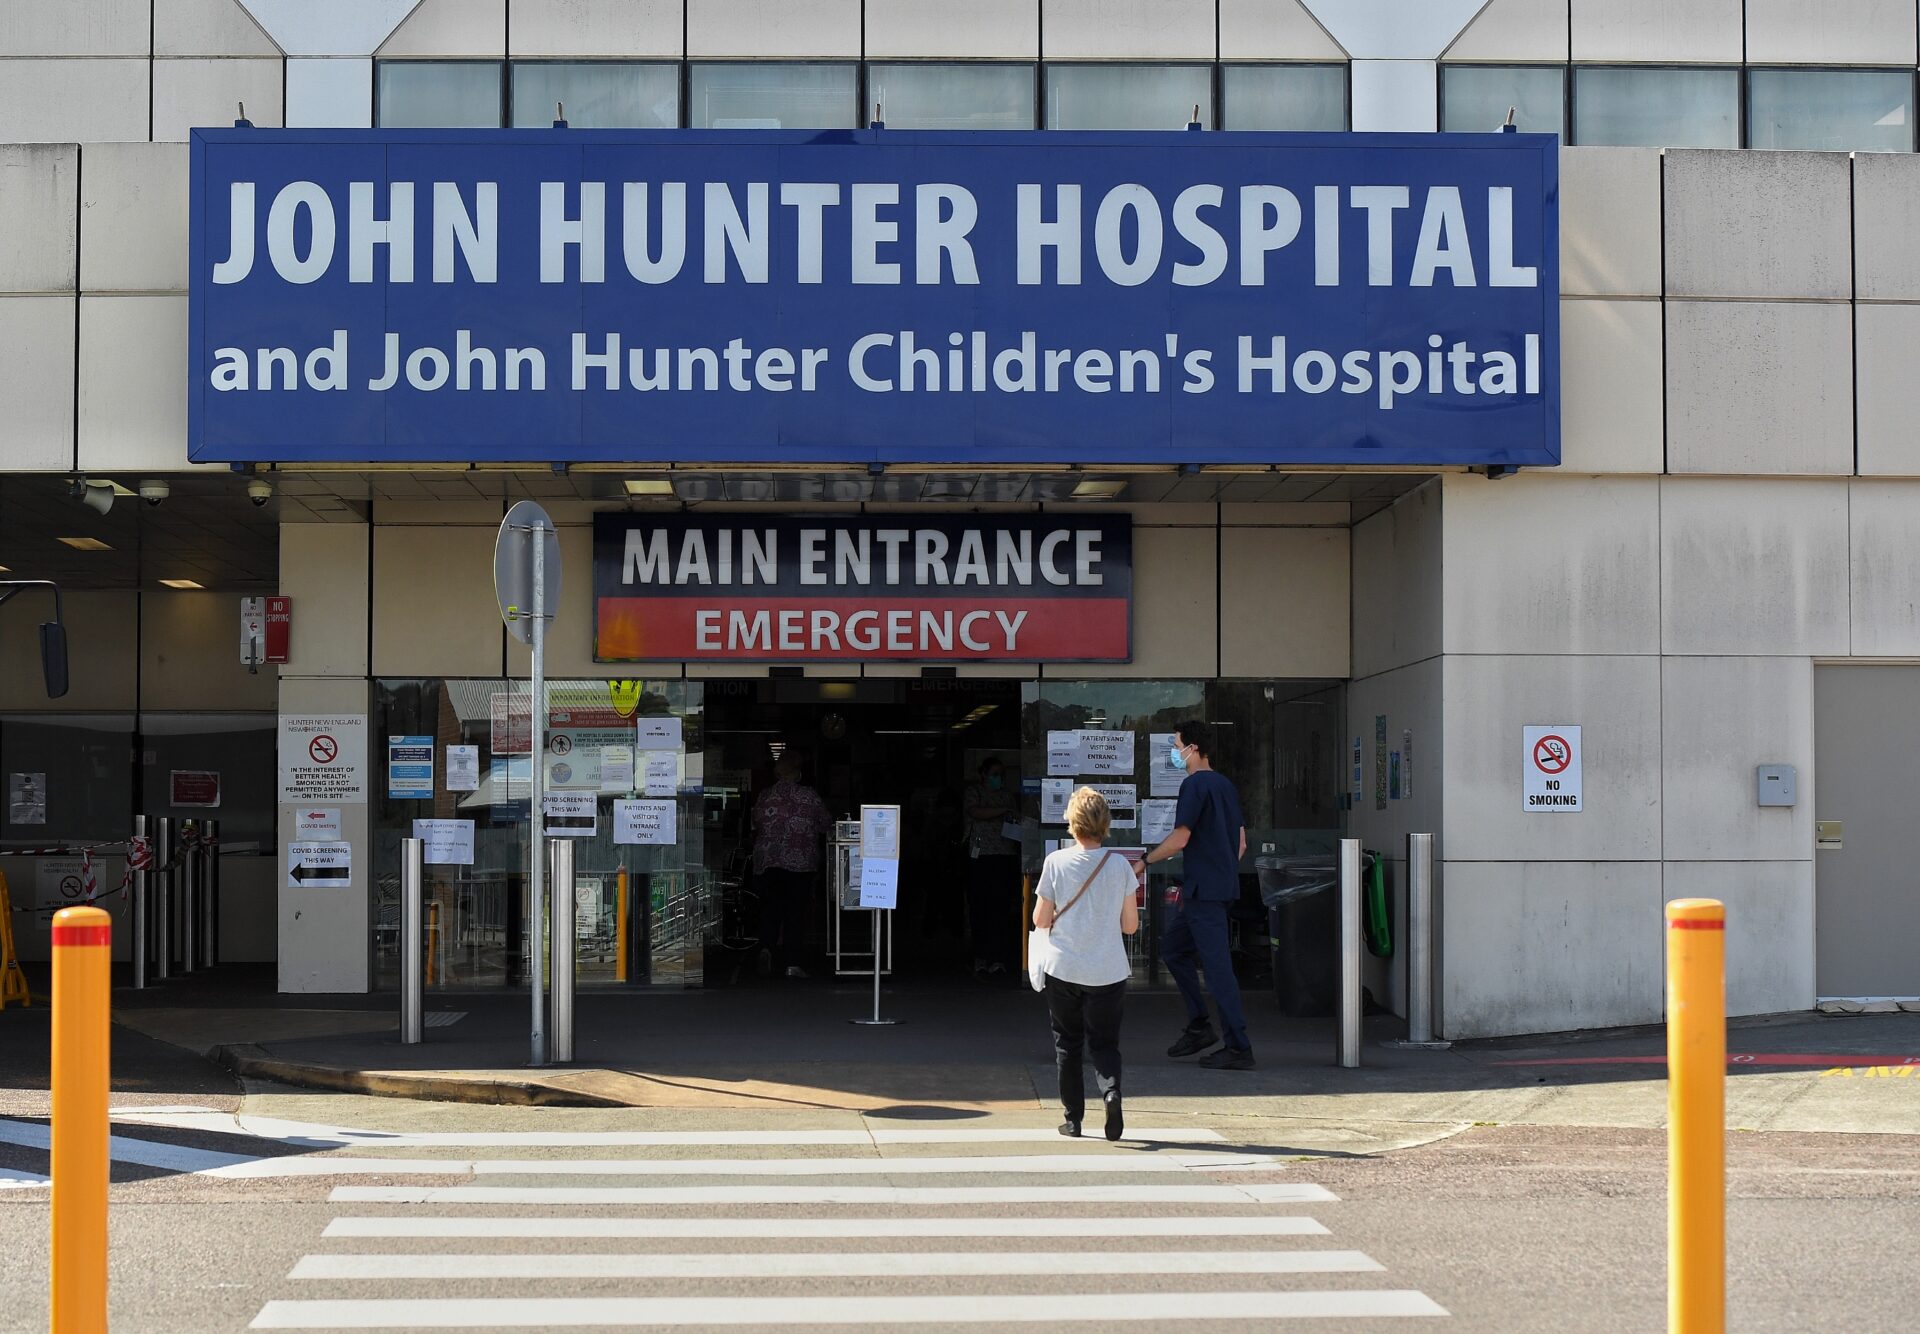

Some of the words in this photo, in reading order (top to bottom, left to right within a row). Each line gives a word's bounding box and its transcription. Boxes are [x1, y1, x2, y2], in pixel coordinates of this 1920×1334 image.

[211, 181, 498, 285] JOHN
[539, 182, 981, 287] HUNTER
[1016, 183, 1539, 288] HOSPITAL
[210, 329, 348, 392] and
[367, 329, 546, 392] John
[571, 332, 829, 392] Hunter
[847, 331, 1215, 394] Children's
[1237, 332, 1541, 410] Hospital
[620, 528, 779, 586] MAIN
[799, 528, 1105, 587] ENTRANCE
[272, 601, 283, 612] NO
[266, 613, 289, 623] STOPPING
[695, 609, 1029, 652] EMERGENCY
[1545, 780, 1560, 791] NO
[1528, 794, 1578, 806] SMOKING
[632, 813, 659, 821] VISITORS
